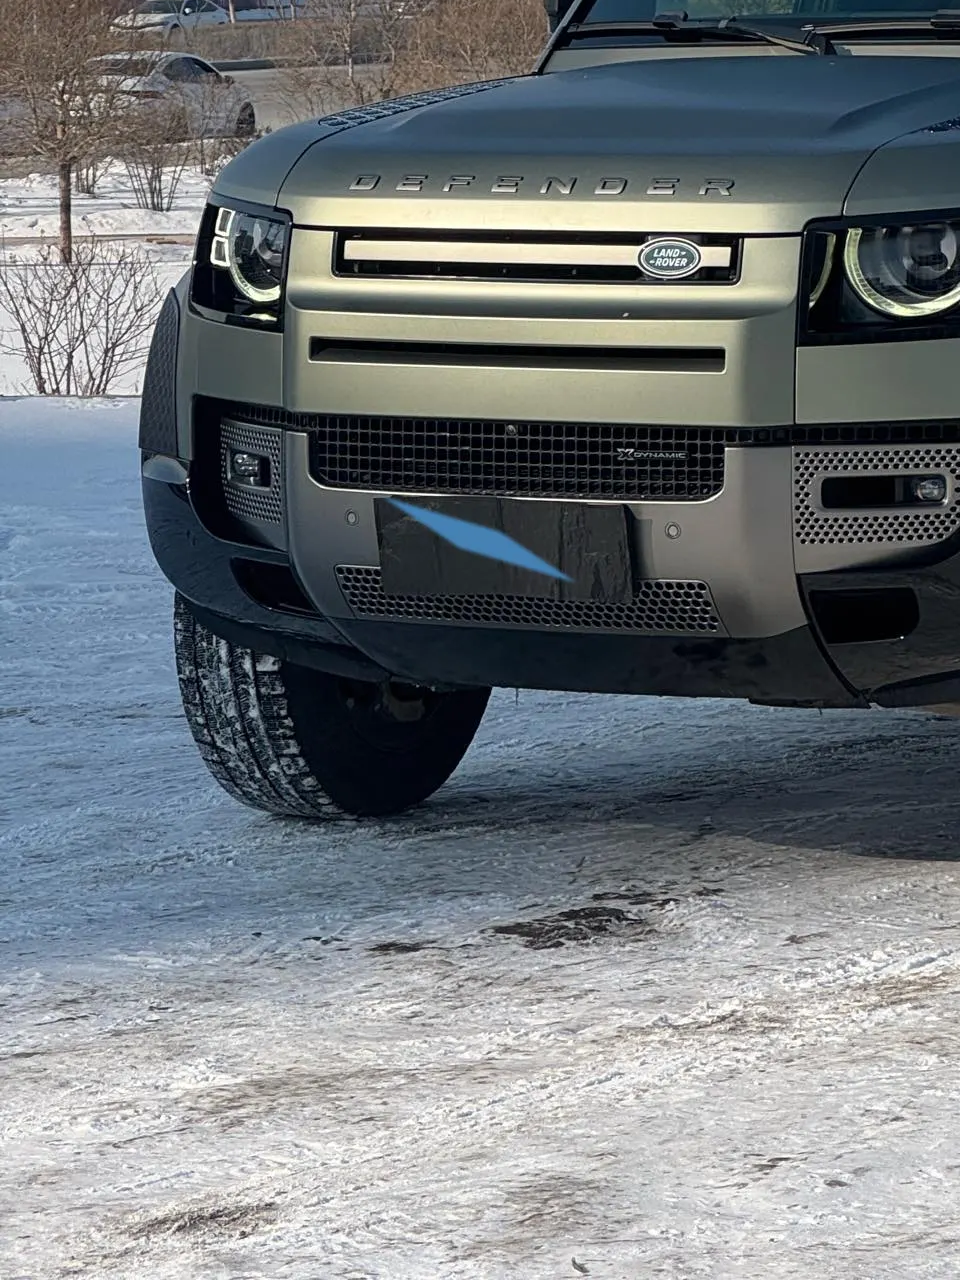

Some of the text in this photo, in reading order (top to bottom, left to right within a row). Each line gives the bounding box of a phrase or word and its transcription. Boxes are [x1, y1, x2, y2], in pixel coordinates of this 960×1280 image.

[349, 174, 735, 197] DEFENDER
[653, 248, 680, 258] LAND
[655, 258, 688, 267] ROVER
